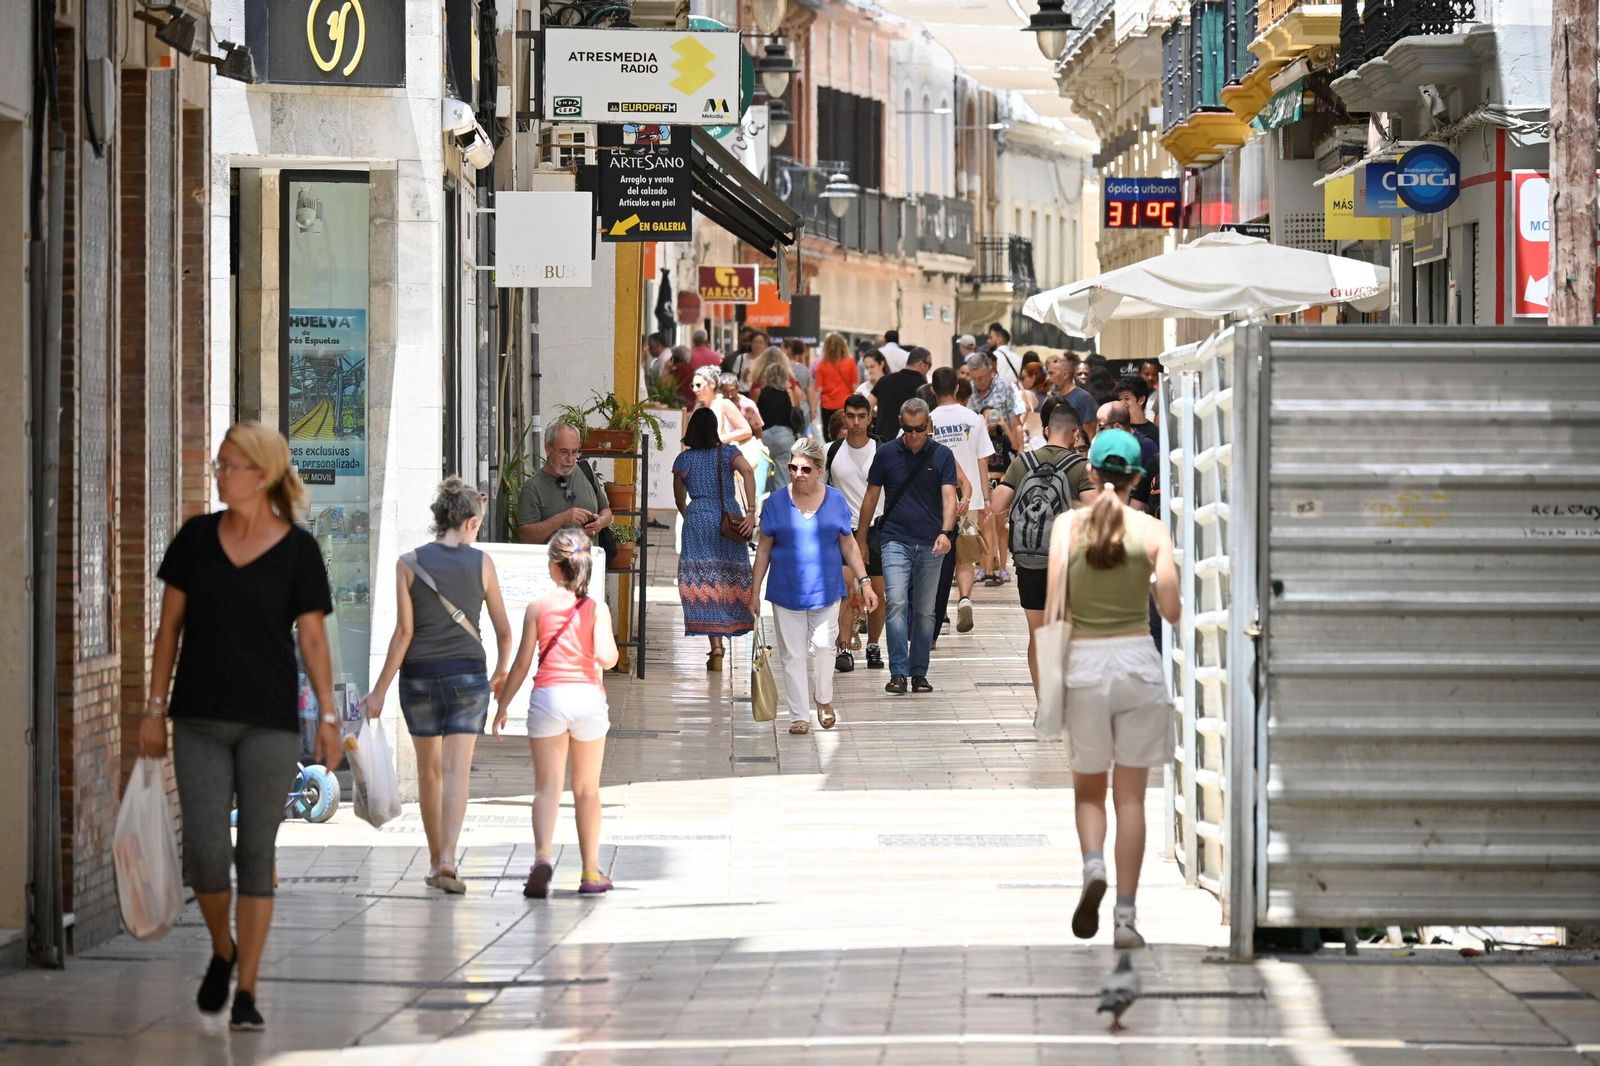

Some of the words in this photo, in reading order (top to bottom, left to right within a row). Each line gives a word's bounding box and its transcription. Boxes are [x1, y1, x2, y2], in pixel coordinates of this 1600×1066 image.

[568, 52, 657, 62] ATRESMEDIA
[621, 64, 658, 73] RADIO
[611, 146, 626, 155] EL
[620, 175, 647, 185] Arreglo
[648, 177, 653, 185] y
[654, 175, 674, 183] venta
[1397, 173, 1456, 186] DIGI
[627, 186, 639, 194] del
[640, 186, 668, 194] calzado
[1107, 183, 1139, 195] óptica
[1141, 184, 1177, 194] urbano
[619, 198, 650, 207] Artículos
[651, 199, 660, 207] en
[662, 198, 676, 208] piel
[1333, 199, 1353, 210] MÁS
[639, 222, 651, 231] EN
[652, 222, 687, 231] GALERIA
[701, 287, 753, 298] TABACOS
[289, 315, 351, 328] HUELVA
[305, 336, 340, 346] Espuelas
[305, 446, 350, 456] exclusivas
[302, 458, 360, 469] personalizada
[311, 473, 333, 481] MOVIL
